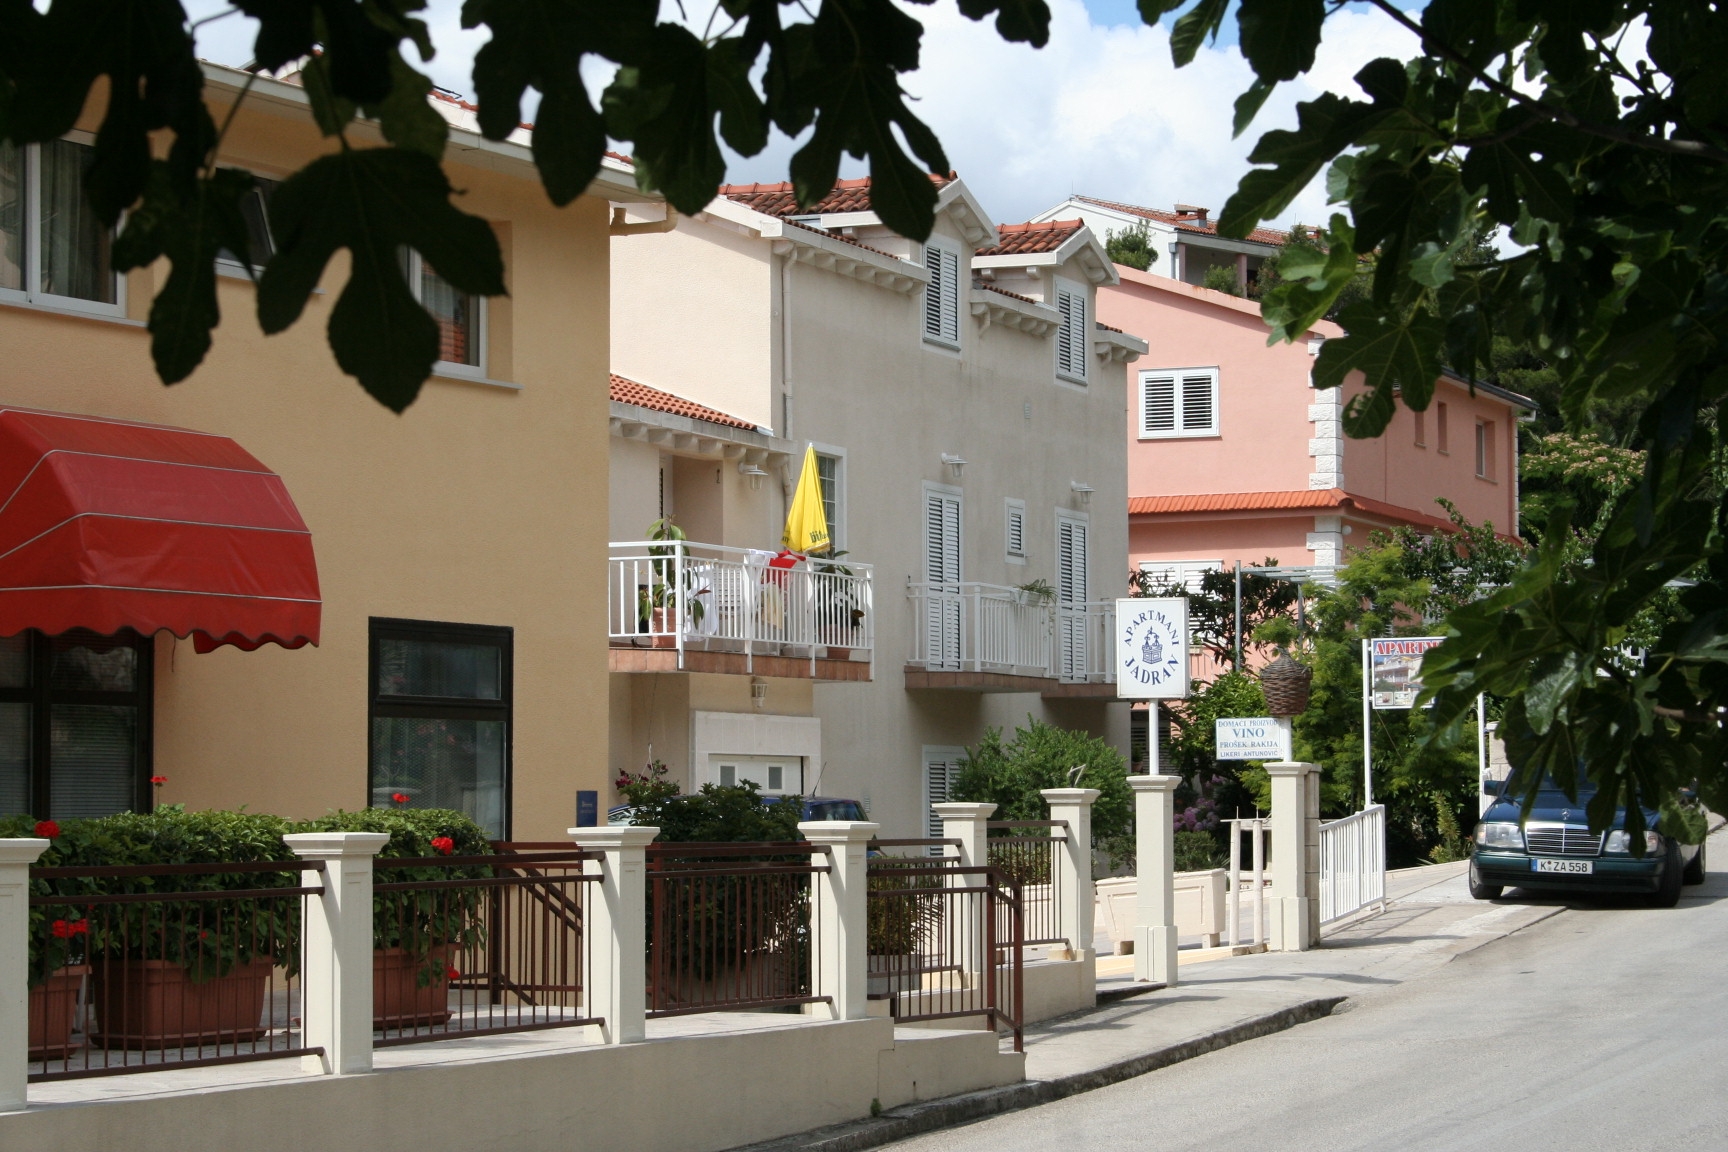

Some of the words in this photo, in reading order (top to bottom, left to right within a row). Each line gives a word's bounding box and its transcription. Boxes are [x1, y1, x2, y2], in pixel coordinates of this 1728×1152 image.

[1124, 610, 1180, 647] APARTMANI
[1124, 654, 1180, 686] JADRAN
[1232, 727, 1265, 738] VINO
[1250, 740, 1279, 748] RAKIJA
